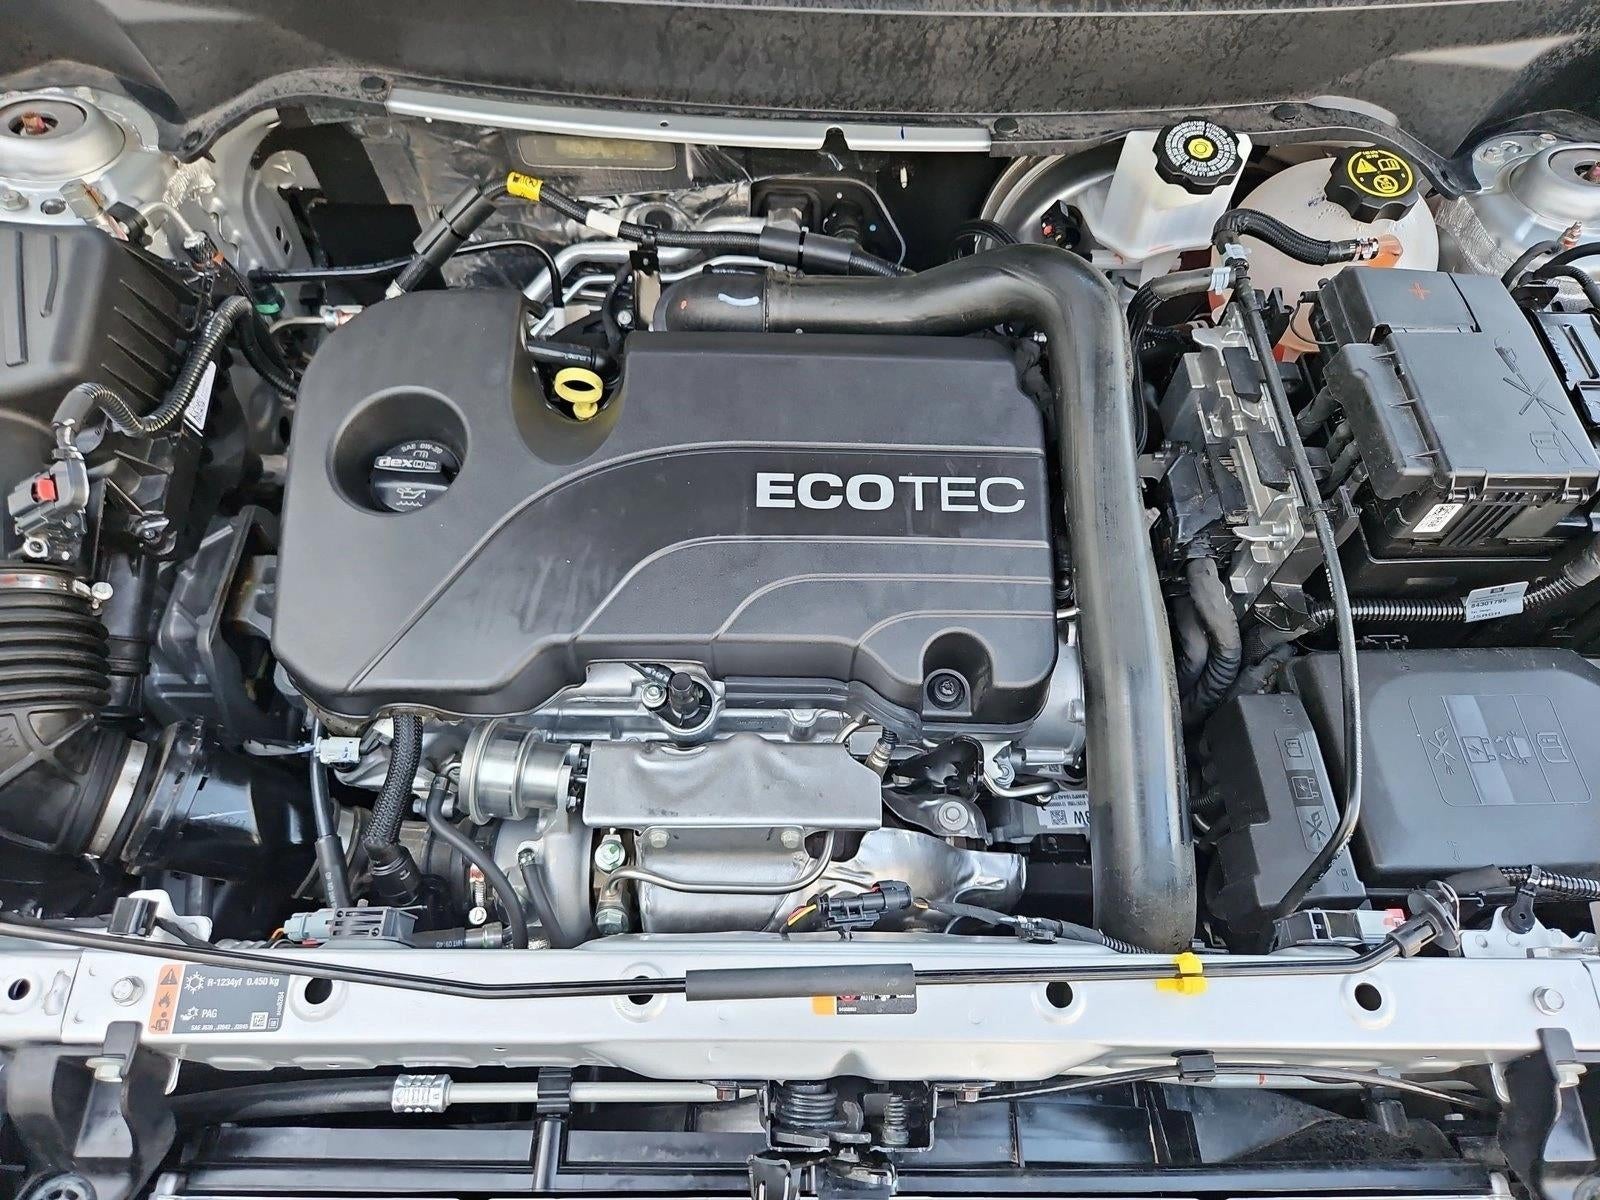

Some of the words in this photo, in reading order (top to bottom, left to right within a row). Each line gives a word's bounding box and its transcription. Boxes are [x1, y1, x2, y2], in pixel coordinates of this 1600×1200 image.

[378, 457, 438, 470] dexos
[756, 472, 1026, 513] ECOTEC
[206, 976, 242, 989] R-1234yf
[246, 977, 269, 987] 0.450
[269, 977, 280, 988] kg
[201, 1008, 218, 1019] PAG
